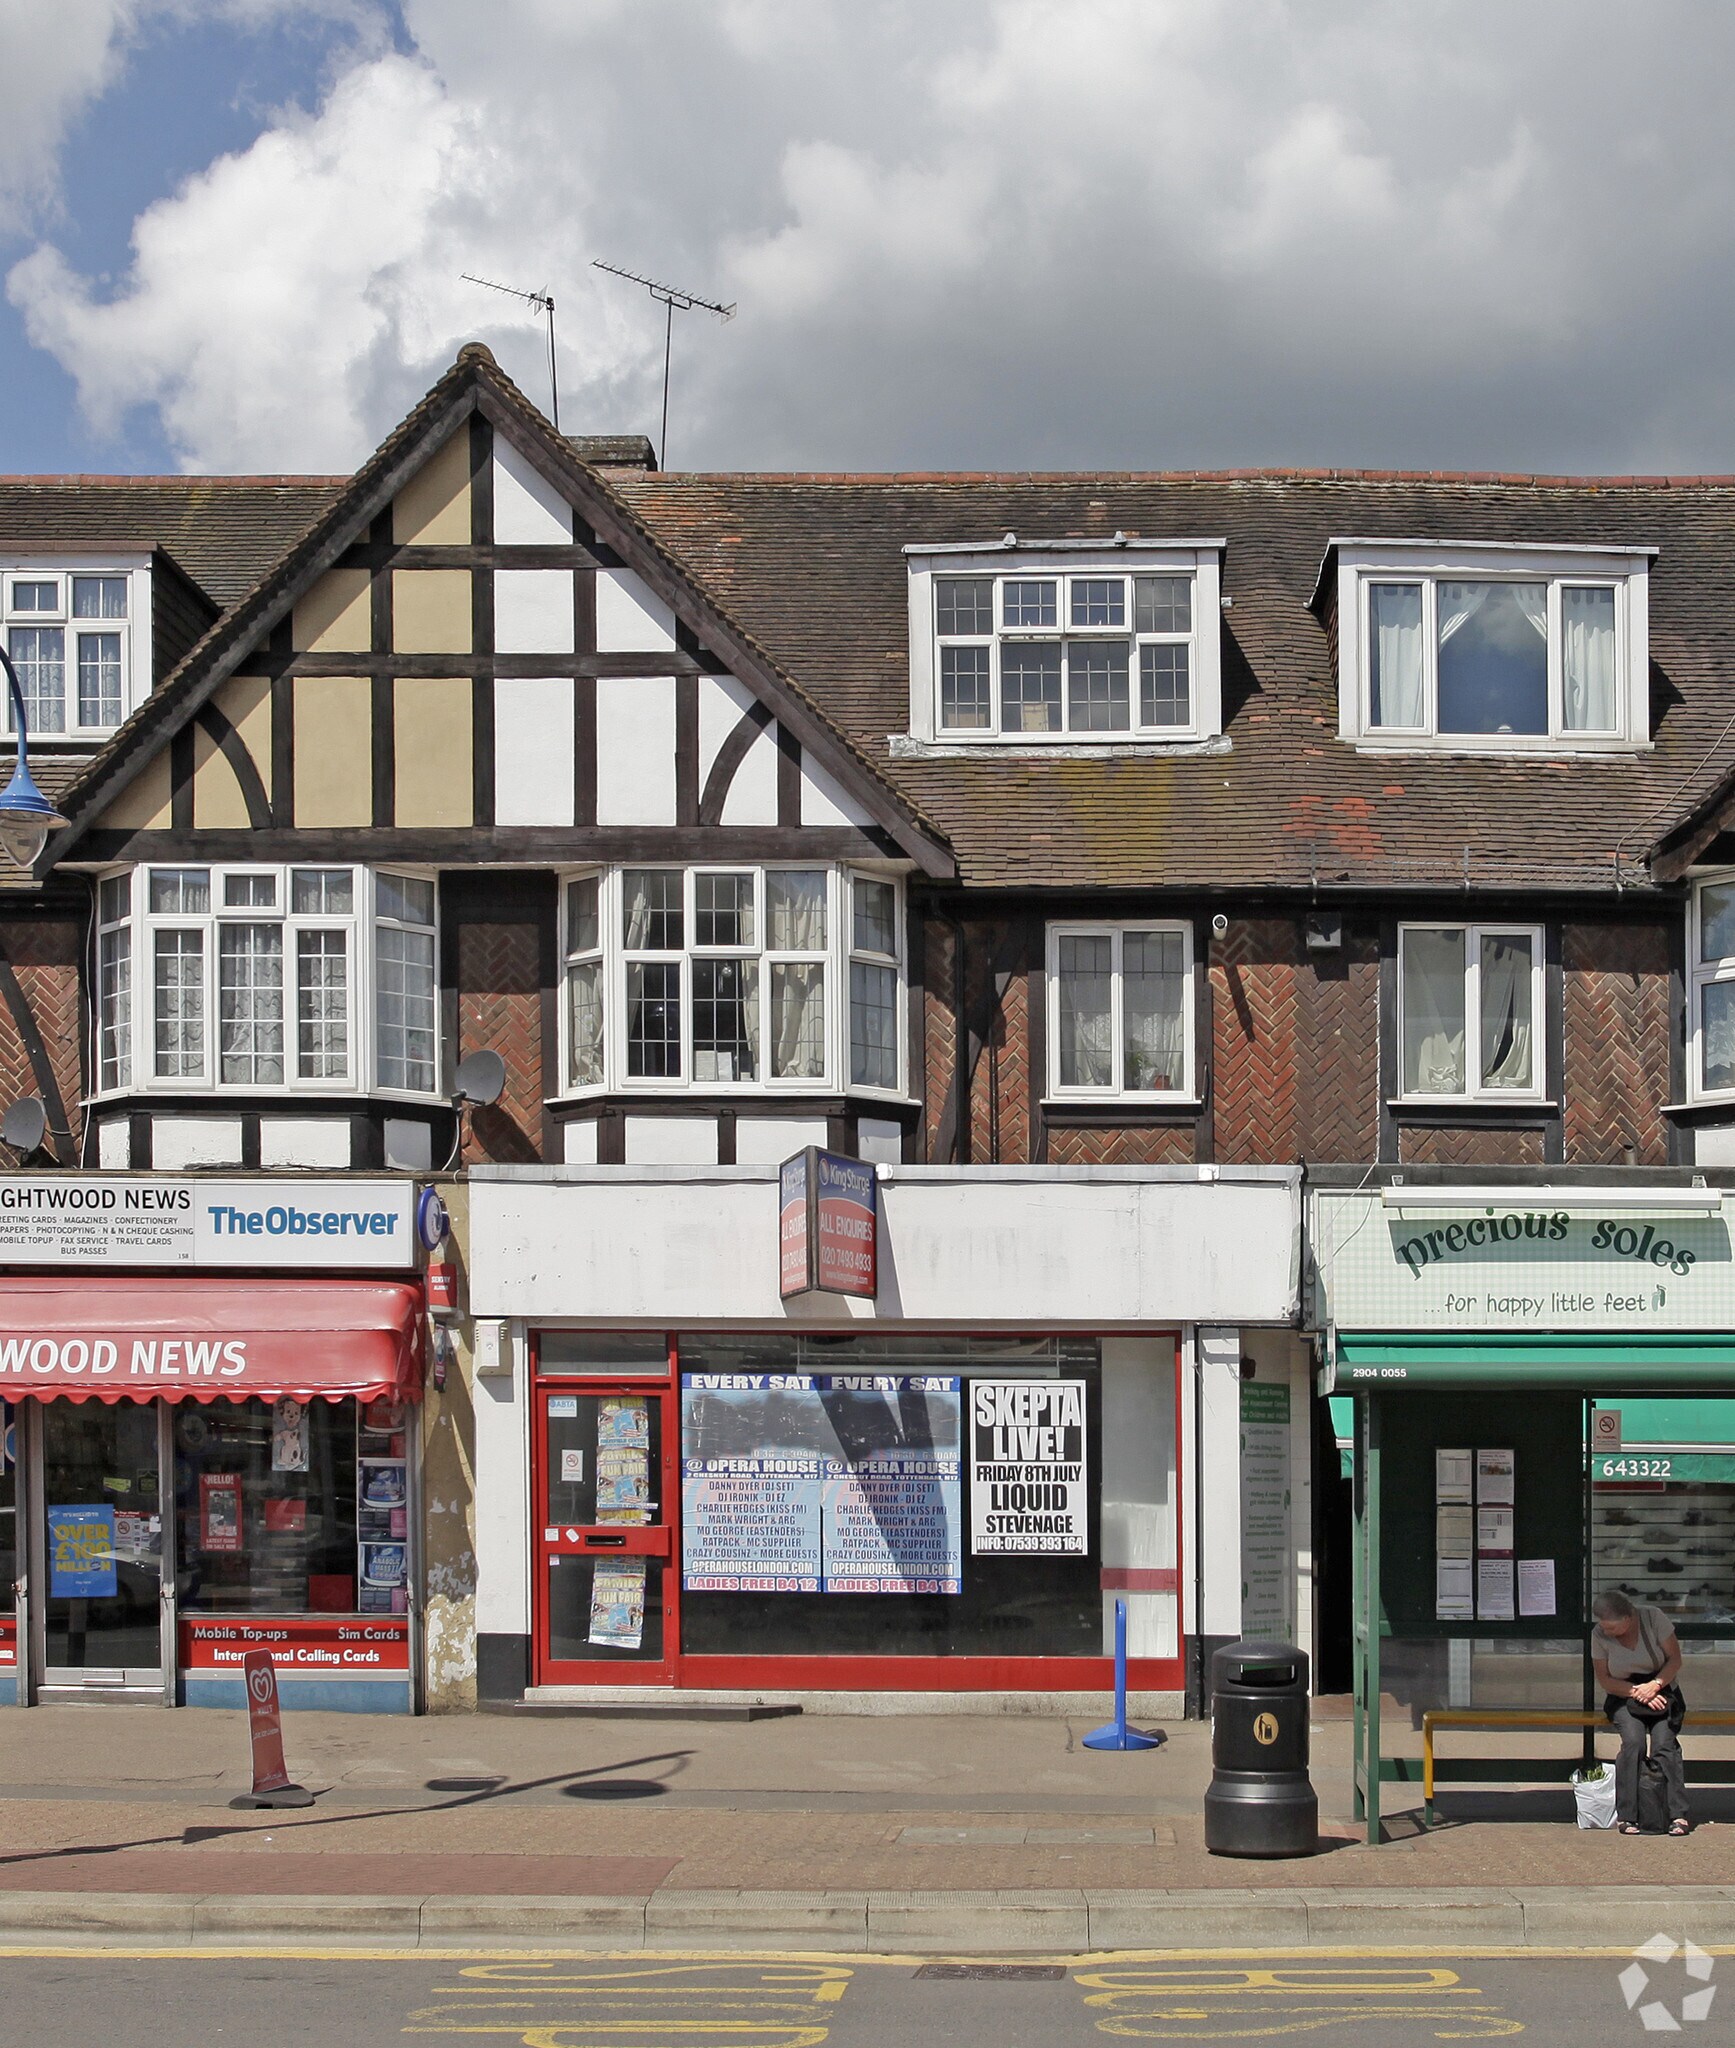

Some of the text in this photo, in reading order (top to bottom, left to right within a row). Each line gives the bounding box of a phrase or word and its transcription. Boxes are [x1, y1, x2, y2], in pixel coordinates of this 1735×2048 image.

[1, 1188, 191, 1210] GHTWOOD NEWS
[31, 1216, 57, 1224] CARDS
[64, 1216, 108, 1224] MAGAZINES
[114, 1217, 178, 1225] CONFECTIONERY
[820, 1212, 833, 1233] ALL
[1, 1226, 194, 1236] PAPERS PHOTOCOPYING N & N CHEQUE CASHING
[28, 1236, 54, 1245] TOPUP
[60, 1237, 74, 1245] FAX
[76, 1237, 109, 1245] SERVICE
[115, 1237, 144, 1245] TRAVEL
[146, 1238, 172, 1246] CARDS
[1396, 1206, 1697, 1281] precious soles
[60, 1247, 108, 1255] BUS PASSES
[1486, 1293, 1545, 1318] happy
[1551, 1293, 1596, 1313] little
[1603, 1293, 1647, 1313] feet
[130, 1340, 247, 1376] NEWS
[1353, 1368, 1407, 1379] 2904 0055
[691, 1374, 812, 1390] EVERY SAT
[831, 1376, 954, 1391] EVERY SAT
[976, 1386, 1082, 1427] SKEPTA
[993, 1426, 1065, 1461] LIVE!
[686, 1458, 818, 1473] @ OPERA HOUSE
[826, 1460, 958, 1475] @ OPERA HOUSE
[1602, 1459, 1671, 1477] 643322
[205, 1474, 234, 1485] HELLO!
[976, 1465, 1082, 1482] FRIDAY 8TH JULY
[709, 1481, 737, 1491] DANNY
[738, 1481, 760, 1491] DYER
[849, 1482, 877, 1492] DANNY
[879, 1482, 900, 1492] DYER
[718, 1492, 786, 1503] DJ IRONIK DJ EZ
[858, 1494, 926, 1504] DJ IRONIK DJ EZ
[991, 1484, 1068, 1513] LIQUID
[696, 1503, 731, 1513] CHARLIE
[733, 1503, 765, 1513] HEDGES
[836, 1504, 872, 1515] CHARLIE
[873, 1505, 905, 1515] HEDGES
[708, 1515, 733, 1524] MARK
[734, 1515, 768, 1525] WRIGHT
[778, 1515, 796, 1525] ARG
[848, 1516, 873, 1526] MARK
[875, 1517, 909, 1527] WRIGHT
[918, 1517, 936, 1527] ARG
[985, 1515, 1073, 1533] STEVENAGE
[54, 1523, 110, 1541] OVER
[697, 1526, 711, 1535] MO
[712, 1526, 744, 1536] GEORGE
[837, 1527, 851, 1537] MO
[852, 1528, 884, 1537] GEORGE
[702, 1537, 802, 1548] RATPACK MC SUPPLIER
[842, 1538, 942, 1549] RATPACK MC SUPPLIER
[977, 1536, 1083, 1550] INFO: 07539 393 164
[54, 1541, 112, 1561] £100
[686, 1548, 818, 1559] CRAZY COUSINZ MORE GUESTS
[826, 1549, 958, 1561] CRAZY COUSINZ MORE GUESTS
[692, 1560, 814, 1574] OPERAHOUSELONDON.COM
[832, 1562, 954, 1576] OPERAHOUSELONDON.COM
[688, 1577, 818, 1591] LADIES FREE B4 12
[828, 1578, 958, 1593] LADIES FREE B4 12
[194, 1626, 288, 1641] Mobile Top-ups
[338, 1626, 400, 1640] Sim Cards
[297, 1648, 340, 1664] Calling
[343, 1649, 380, 1662] Cards
